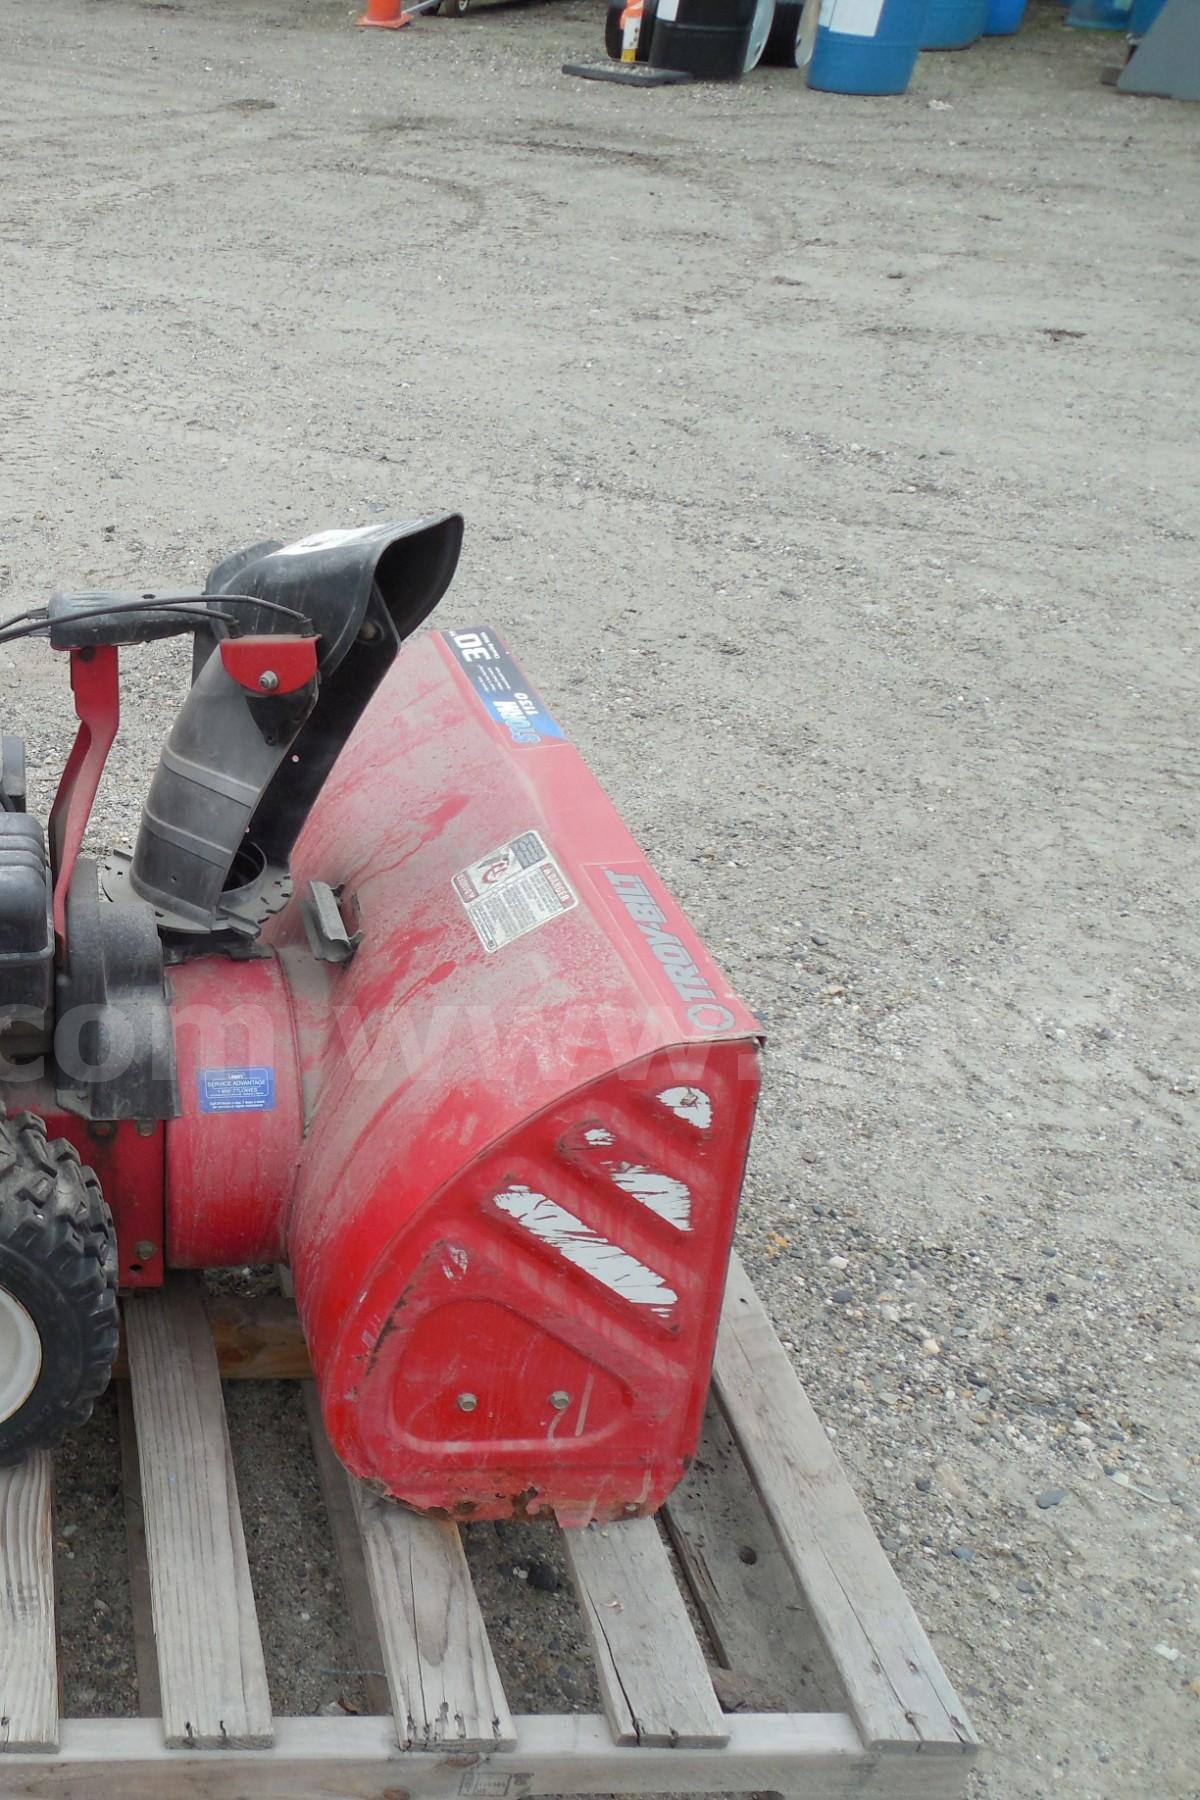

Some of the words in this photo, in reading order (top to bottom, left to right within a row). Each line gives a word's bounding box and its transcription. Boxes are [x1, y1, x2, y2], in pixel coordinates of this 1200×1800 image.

[513, 692, 539, 715] 1130
[492, 701, 541, 743] STORM
[603, 868, 717, 1002] TROY-BILT
[233, 1078, 266, 1088] ADVANTAGE
